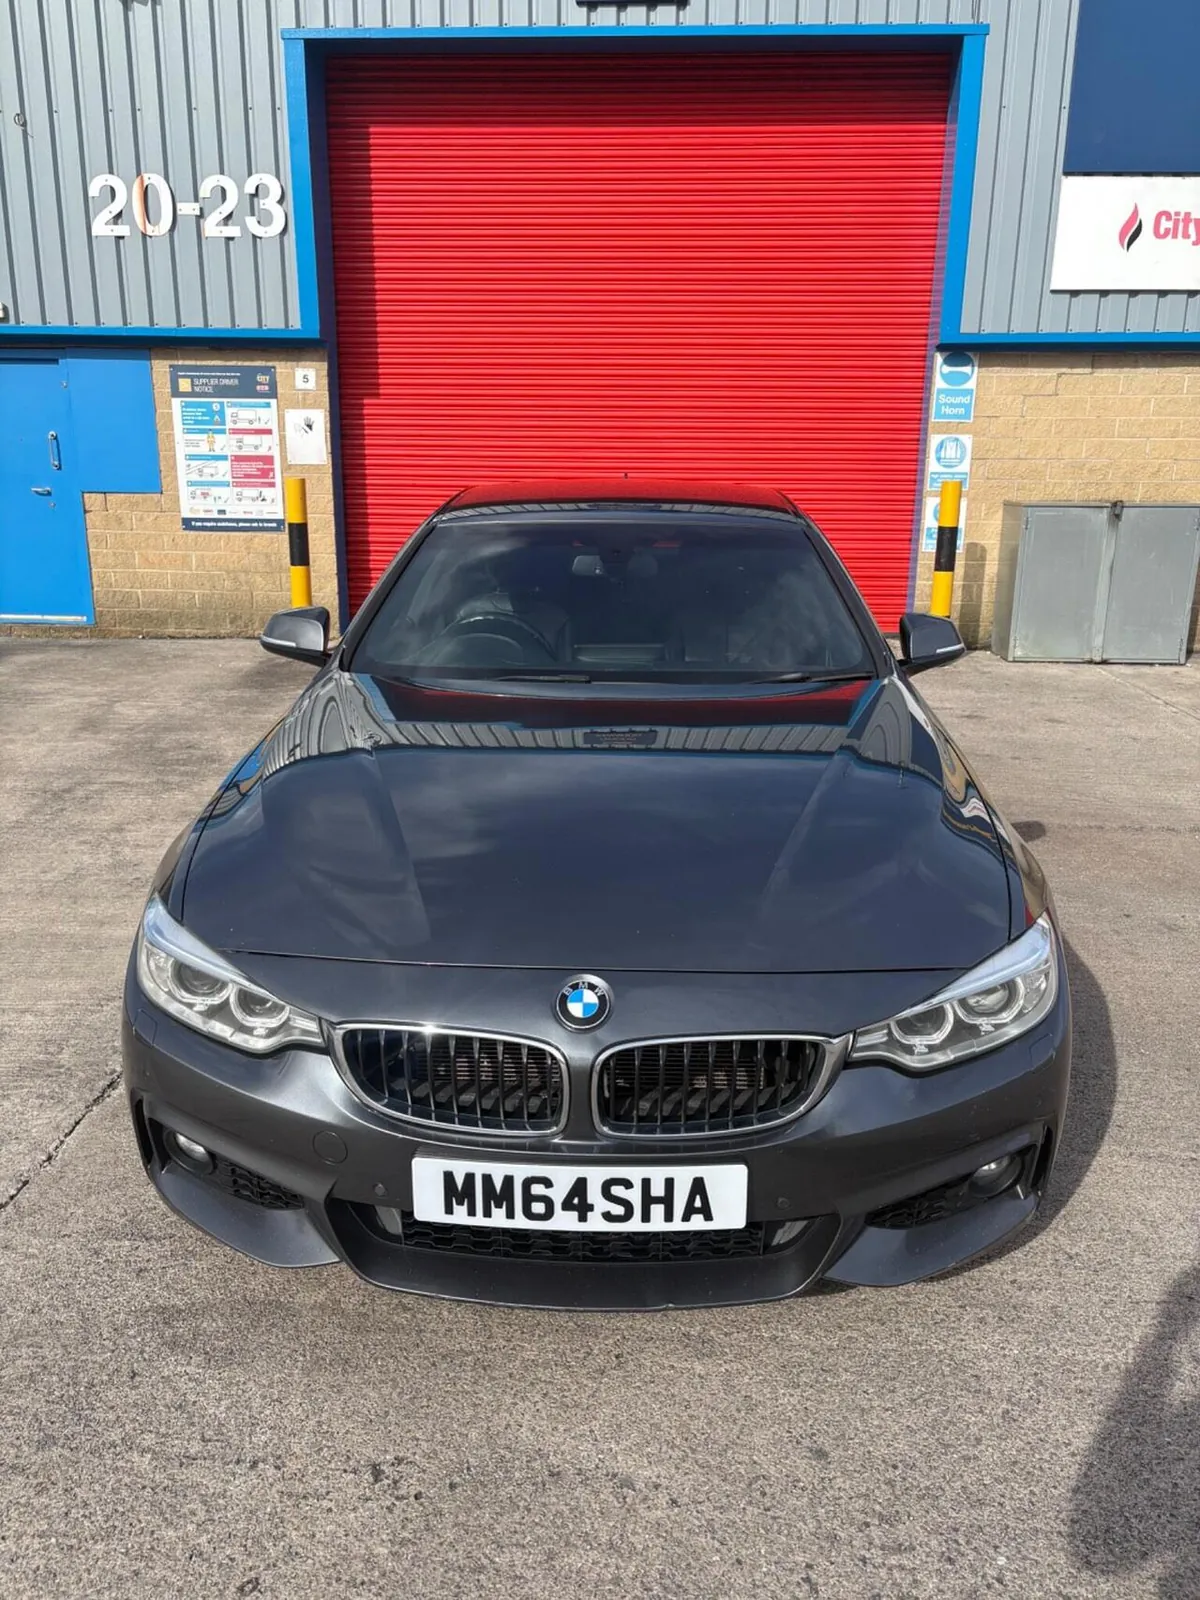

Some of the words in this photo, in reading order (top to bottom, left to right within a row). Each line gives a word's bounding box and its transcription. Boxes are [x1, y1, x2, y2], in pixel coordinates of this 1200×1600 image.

[88, 173, 286, 237] 20-23
[219, 378, 239, 386] DRIVER
[302, 374, 309, 383] 5
[939, 394, 970, 404] Sound
[941, 405, 965, 415] Horn
[563, 981, 605, 996] BMW
[443, 1170, 713, 1223] MM64SHA
